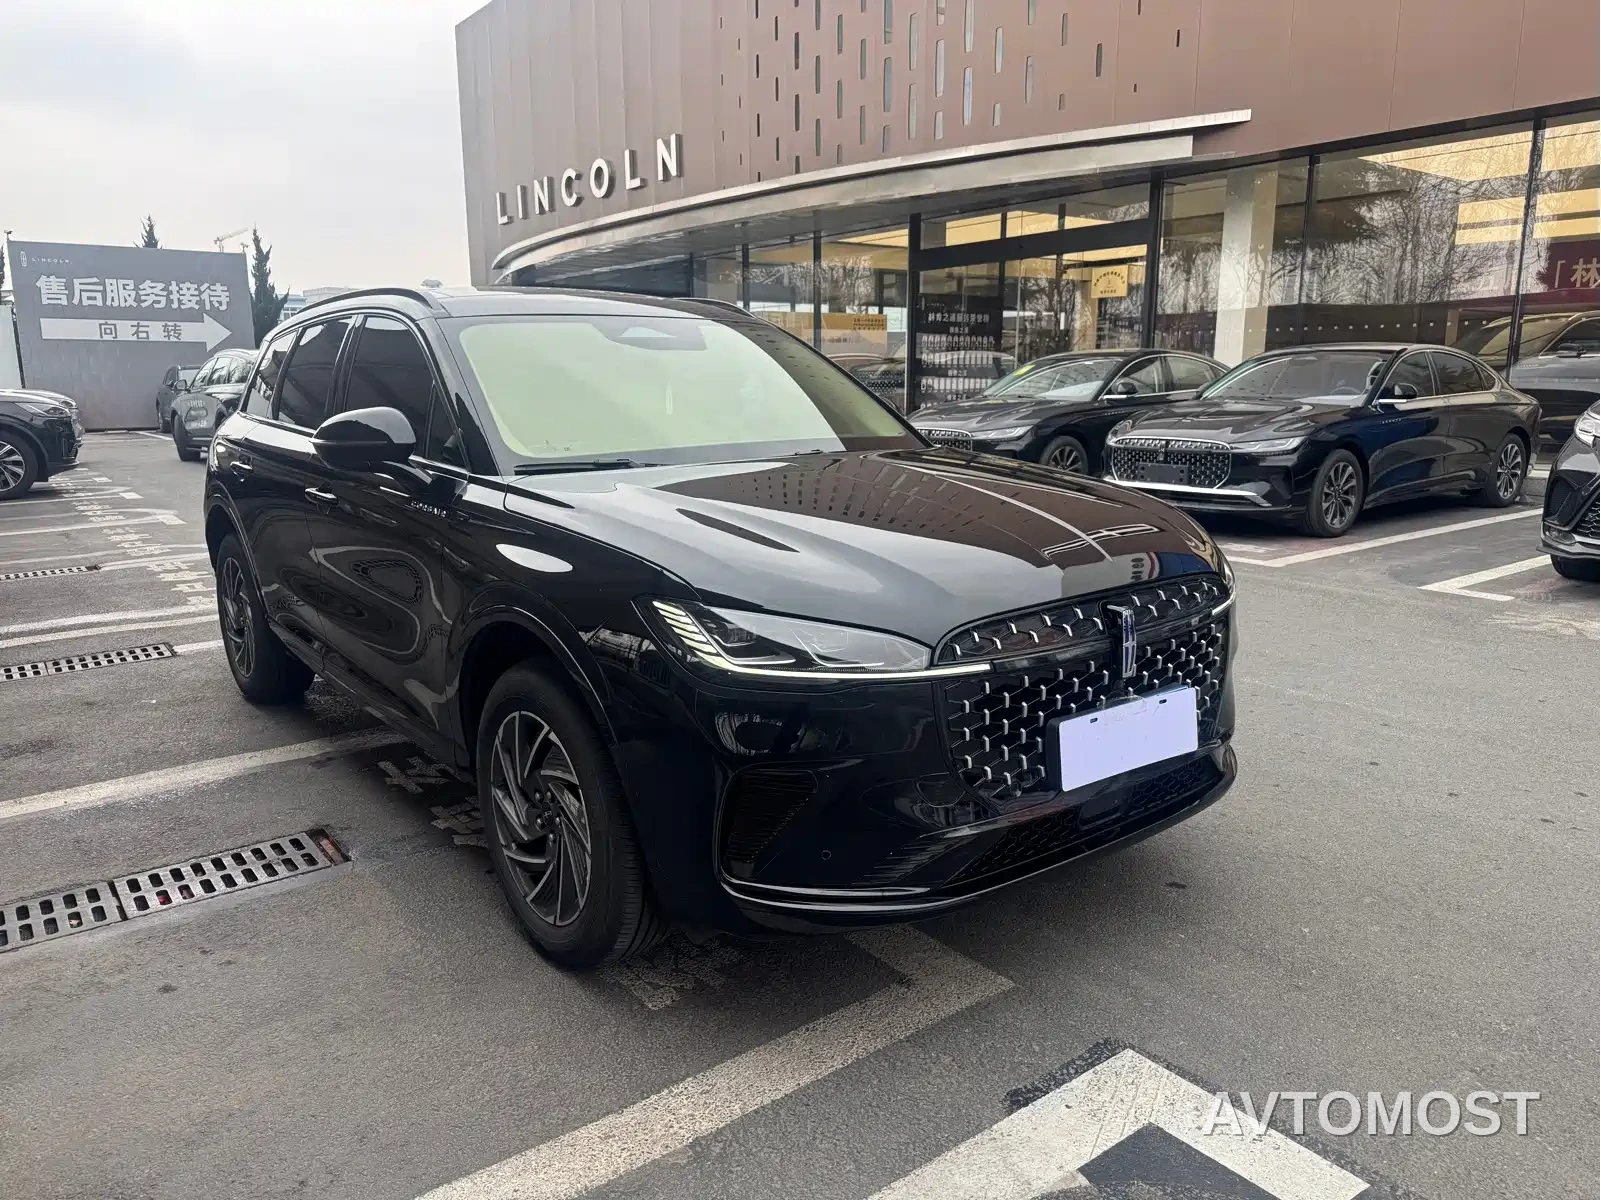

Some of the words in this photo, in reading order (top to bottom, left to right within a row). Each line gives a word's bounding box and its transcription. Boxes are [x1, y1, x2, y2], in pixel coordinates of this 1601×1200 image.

[496, 133, 680, 224] LINCOLN
[35, 274, 230, 311] 售后服务接待
[99, 321, 182, 341] 向右转
